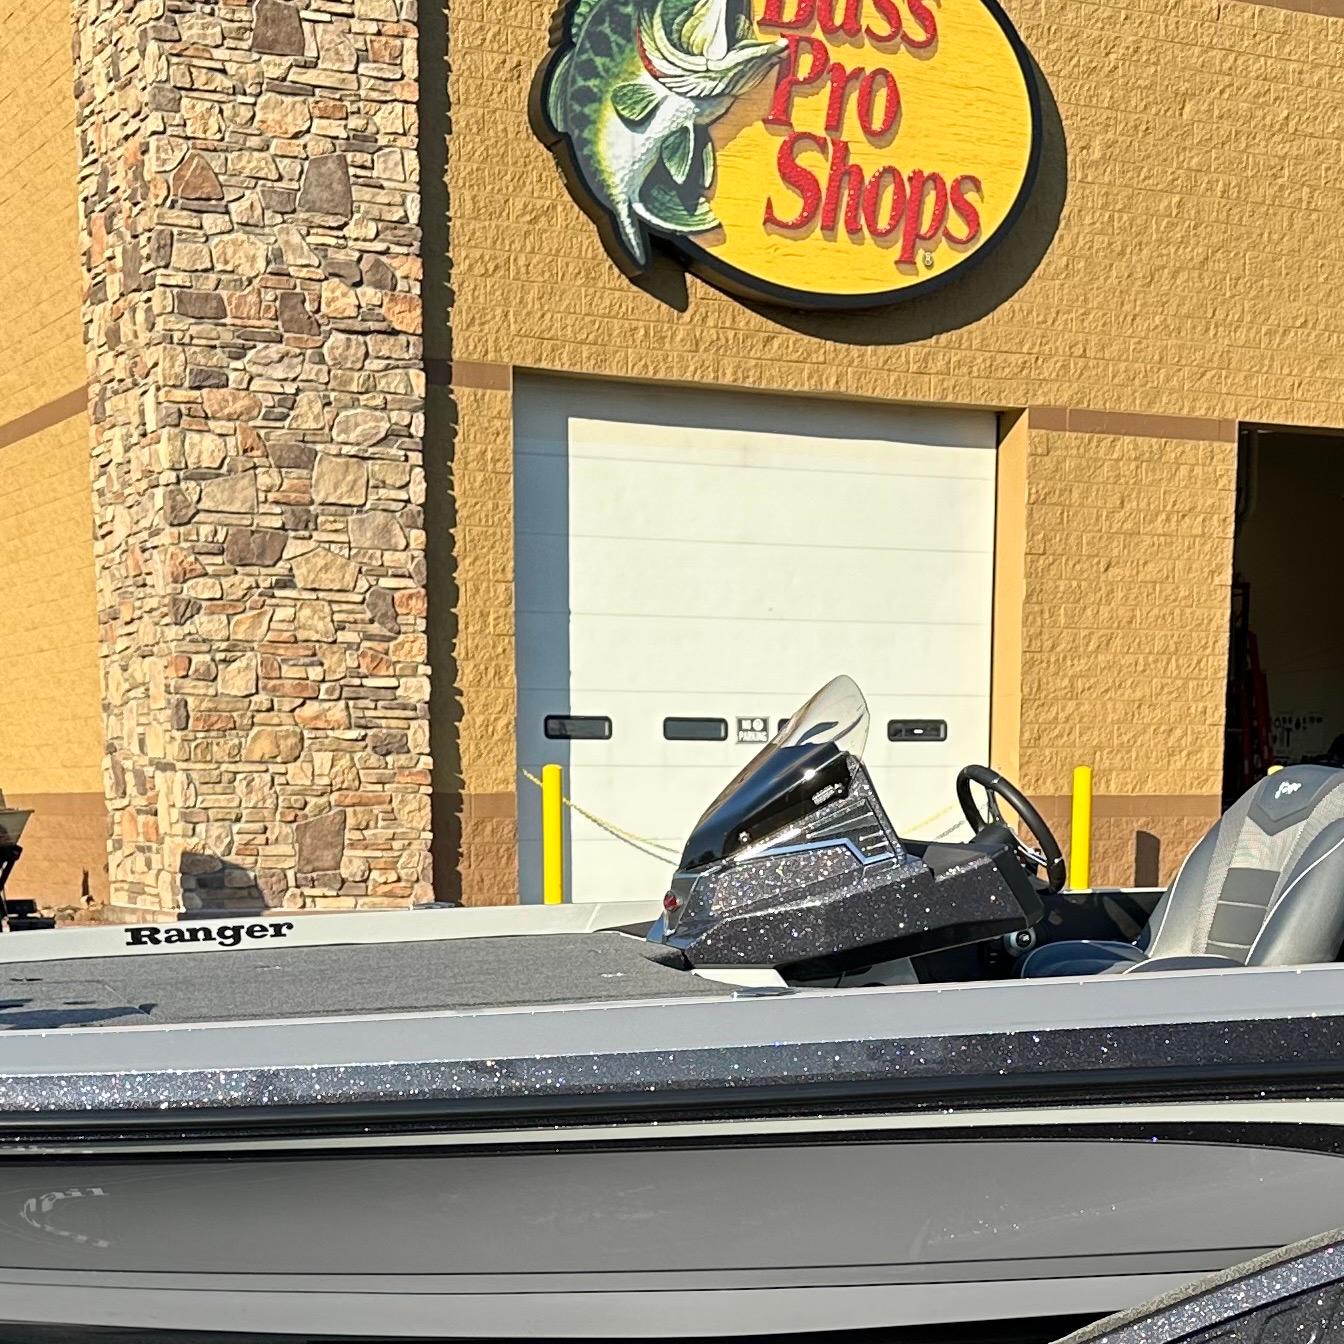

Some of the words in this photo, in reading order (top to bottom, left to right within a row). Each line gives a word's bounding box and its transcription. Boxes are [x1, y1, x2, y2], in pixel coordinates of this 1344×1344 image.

[762, 33, 902, 137] Pro
[763, 132, 984, 264] Shops
[124, 921, 294, 947] Ranger
